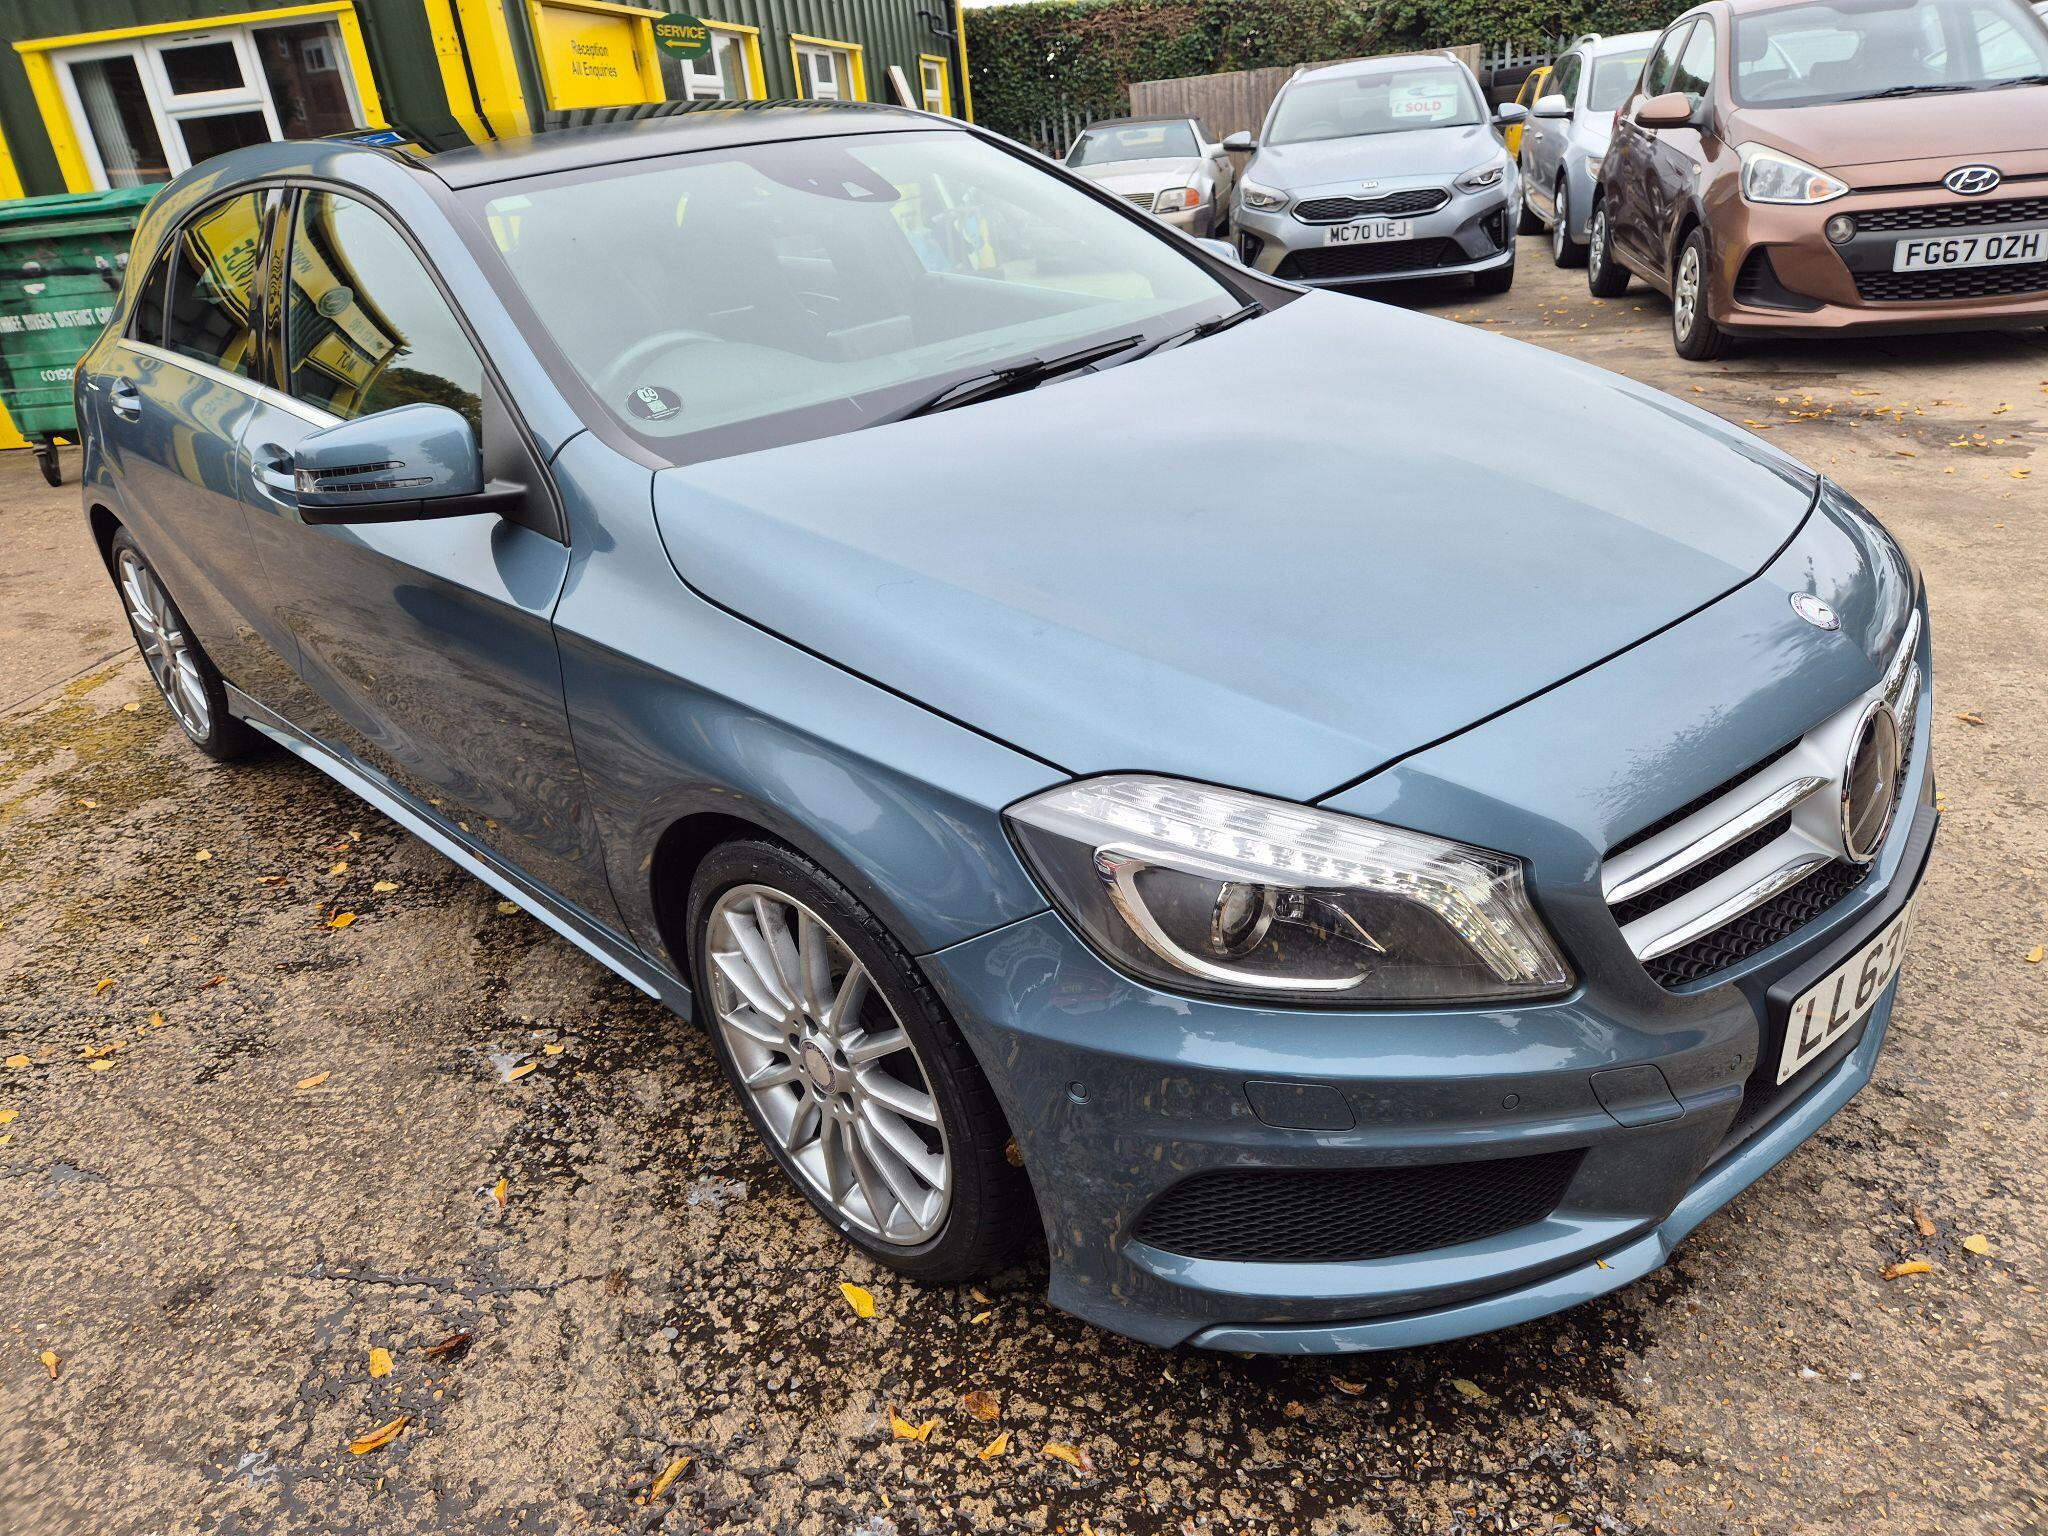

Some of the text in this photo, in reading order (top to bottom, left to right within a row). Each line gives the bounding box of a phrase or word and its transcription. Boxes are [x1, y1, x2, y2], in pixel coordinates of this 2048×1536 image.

[656, 24, 706, 40] SERVICE
[571, 40, 609, 59] Reception
[572, 61, 618, 79] All Enquiries
[1405, 101, 1441, 113] SOLD
[1330, 221, 1406, 243] MC70 UEJ
[1906, 233, 2040, 266] FG67 OZH
[1797, 920, 1903, 1060] LL63
